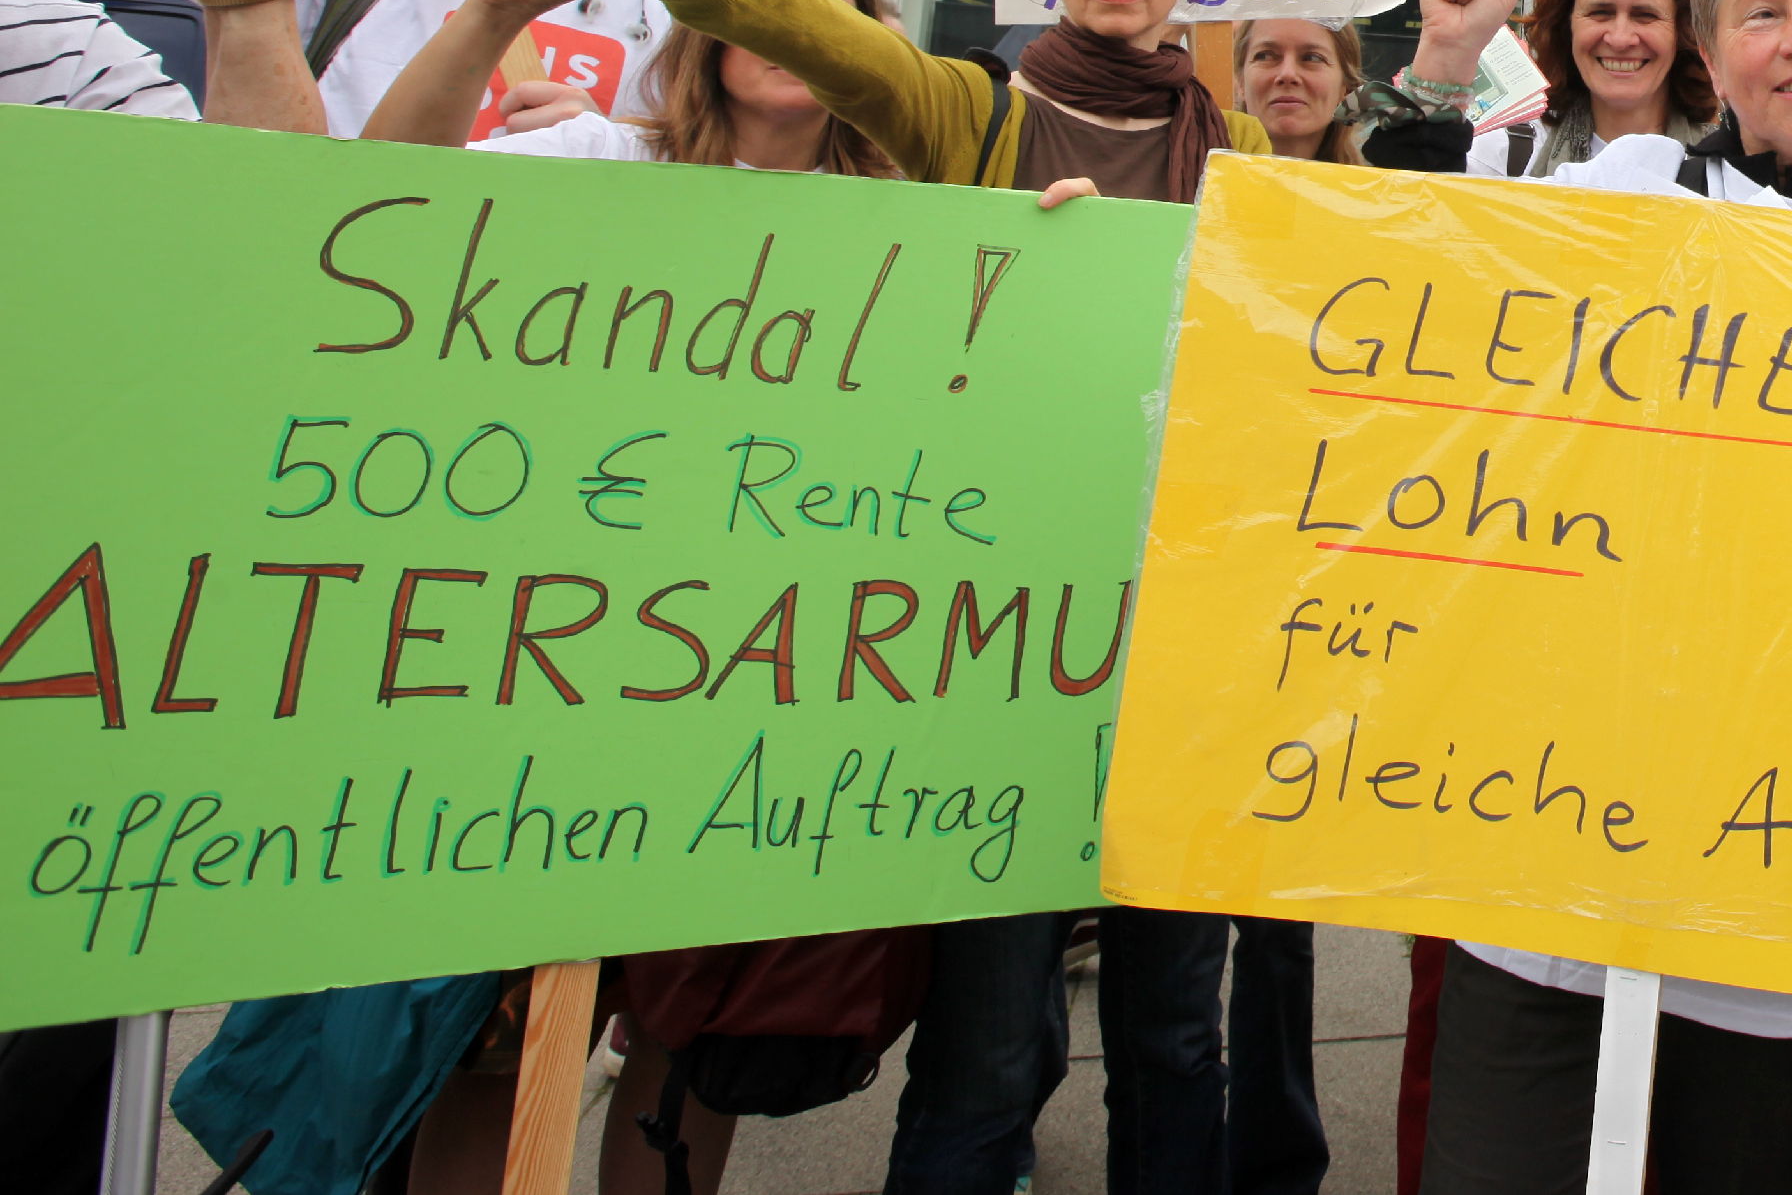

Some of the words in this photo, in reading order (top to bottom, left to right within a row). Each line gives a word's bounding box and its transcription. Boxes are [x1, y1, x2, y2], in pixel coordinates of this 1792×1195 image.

[312, 196, 902, 392] Skandal
[265, 413, 533, 522] 500
[577, 429, 671, 532] €
[725, 432, 999, 547] Rente
[1294, 438, 1624, 564] Lohn
[1275, 595, 1420, 693] für
[28, 755, 650, 957] öffentlichen
[686, 729, 1026, 884] Auftrag
[1249, 711, 1652, 857] gleiche
